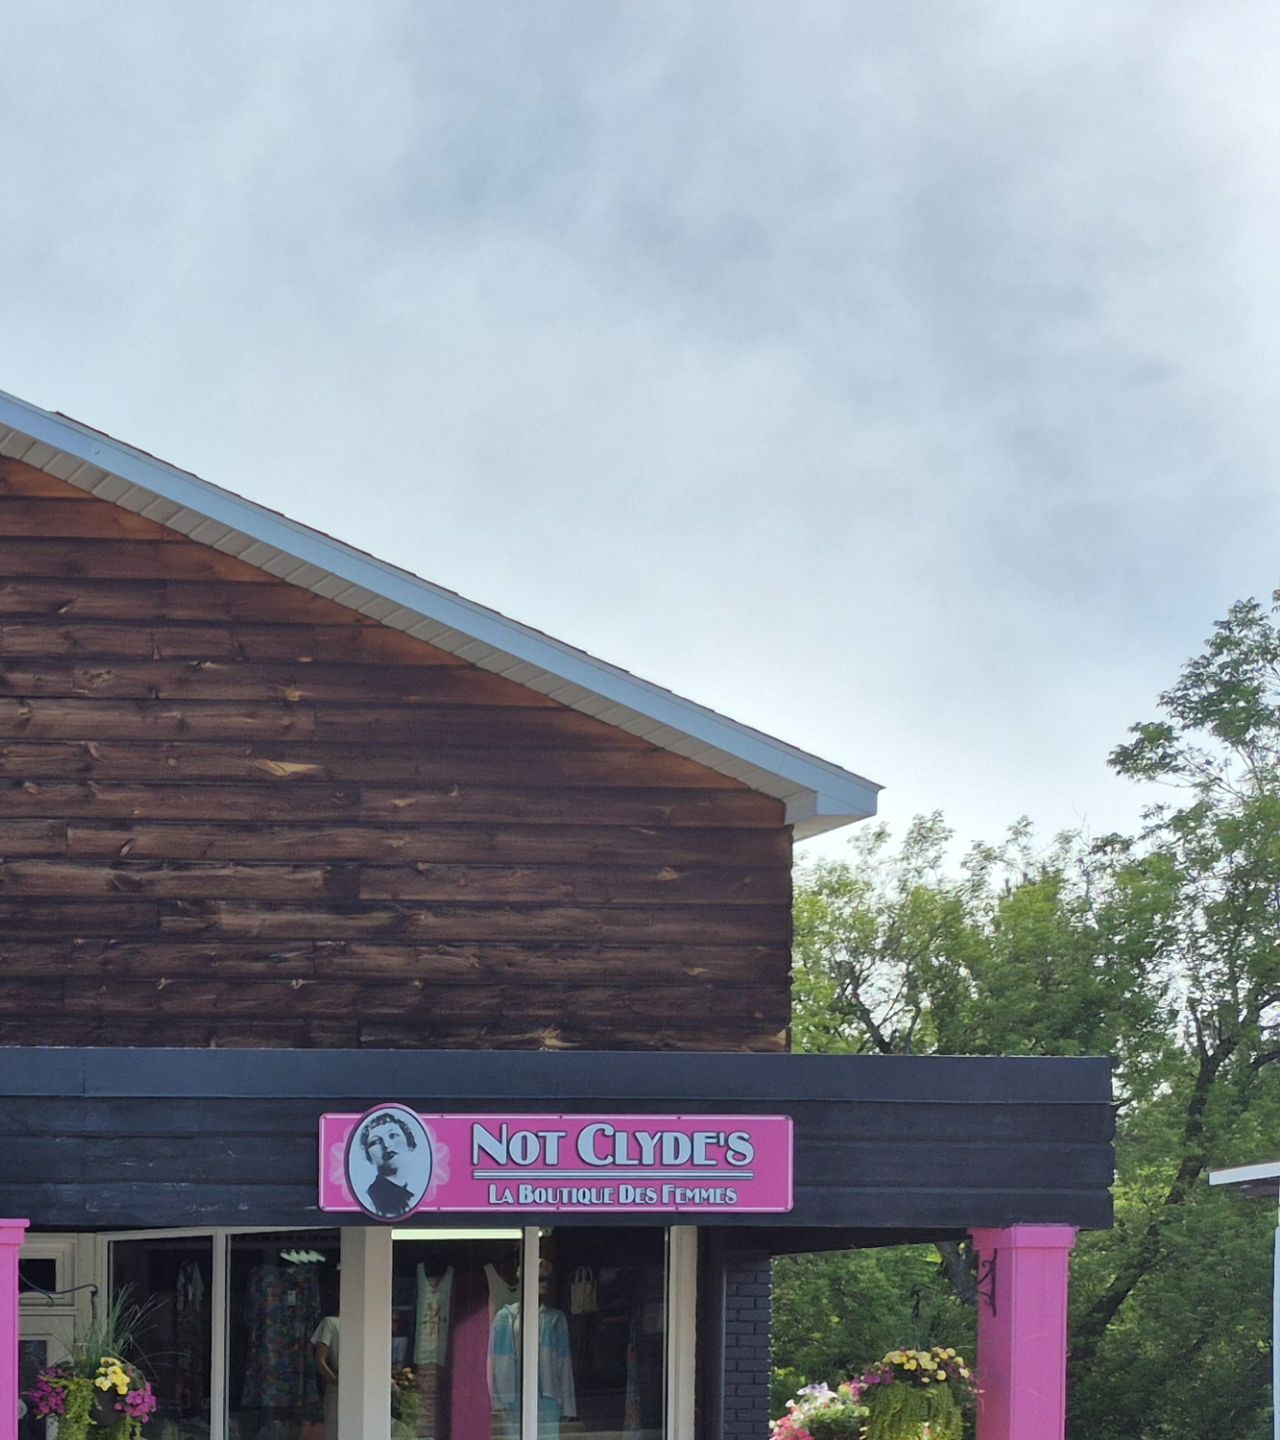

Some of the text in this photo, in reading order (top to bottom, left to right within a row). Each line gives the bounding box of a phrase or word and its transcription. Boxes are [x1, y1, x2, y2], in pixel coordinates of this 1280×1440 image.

[472, 1121, 756, 1167] NOT CLYDE'S
[518, 1183, 616, 1206] BOUTIQUE
[618, 1184, 658, 1206] DES
[661, 1184, 738, 1206] FEMMES
